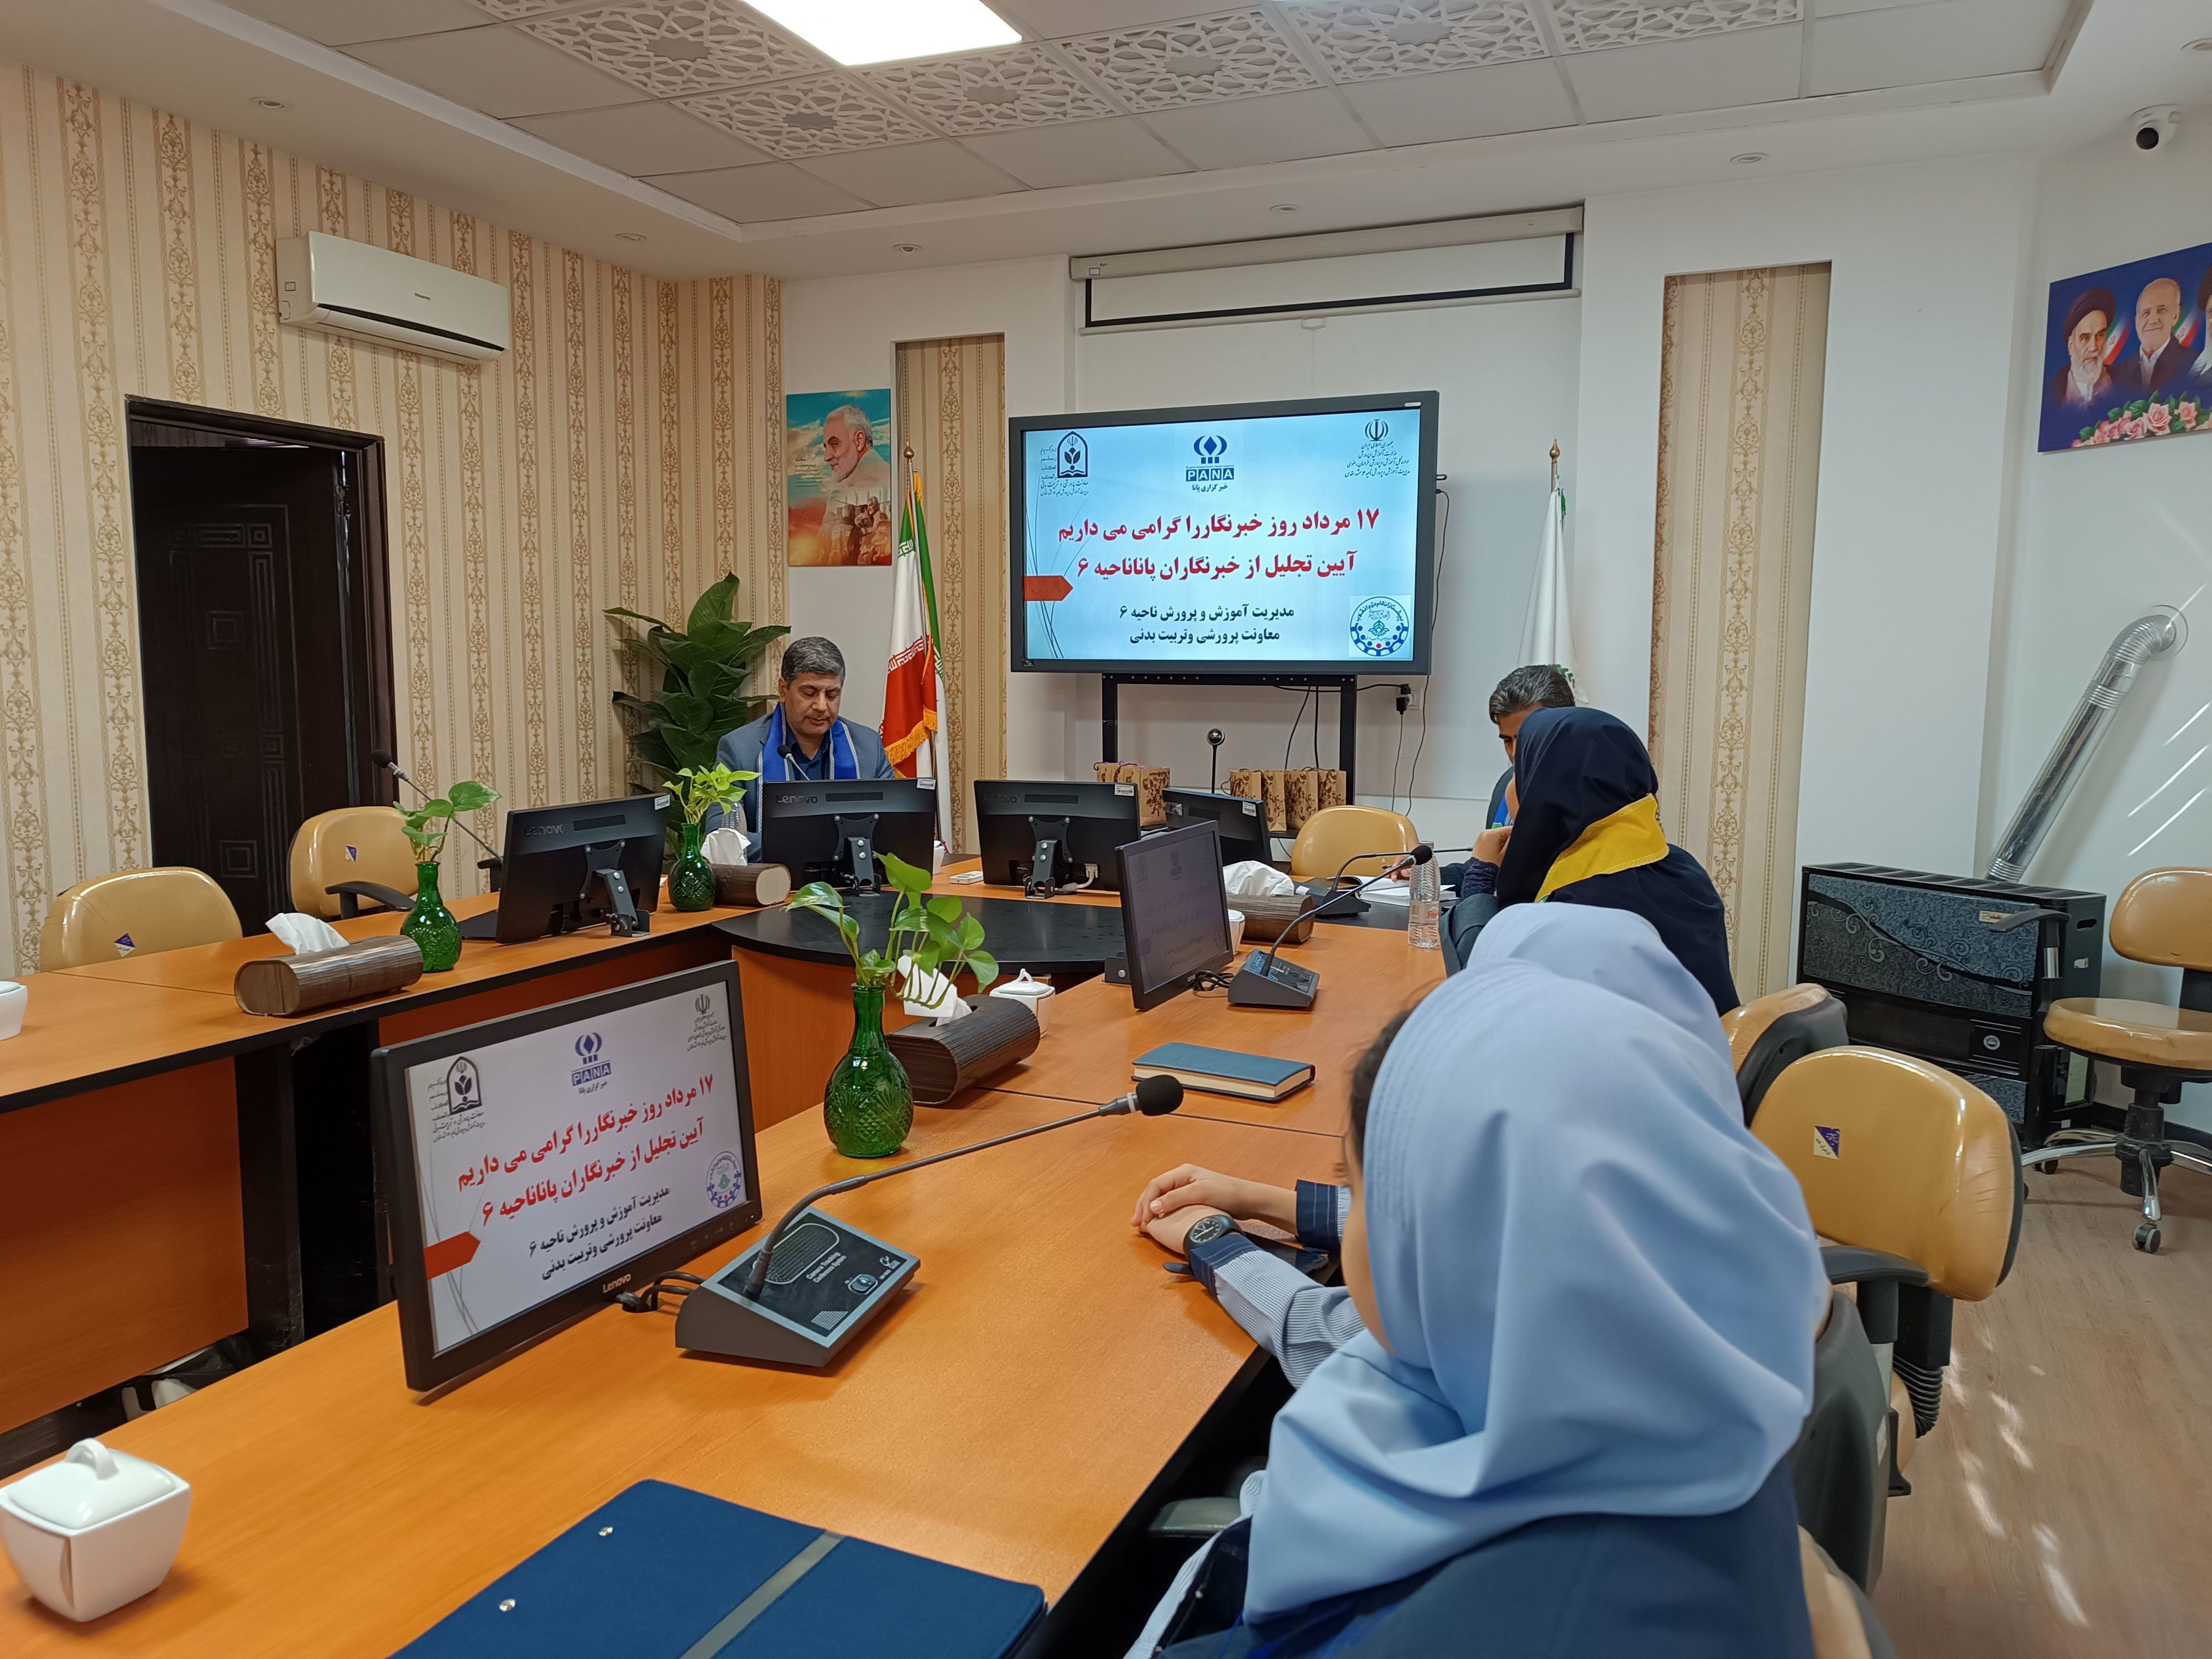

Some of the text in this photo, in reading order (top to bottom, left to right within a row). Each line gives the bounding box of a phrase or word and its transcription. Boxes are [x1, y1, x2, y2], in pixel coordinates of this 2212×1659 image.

[1187, 468, 1234, 481] PANA
[1201, 483, 1218, 492] گزاری
[1218, 483, 1228, 492] خبر
[1131, 515, 1181, 540] گرامی
[1267, 517, 1297, 537] روز
[1302, 510, 1350, 535] مرداد
[1357, 508, 1379, 529] ۱۷
[1058, 518, 1098, 542] داریم
[1103, 524, 1127, 541] می
[1078, 557, 1089, 577] ۶
[1160, 555, 1240, 581] خبرنگاران
[1244, 555, 1260, 579] از
[1265, 554, 1312, 578] تجلیل
[1317, 550, 1358, 577] آیین
[1119, 603, 1295, 622] مدیریت آموزش و پرورش ناحیه ۶
[1130, 628, 1156, 644] بدنی
[1196, 628, 1239, 645] پرورشی
[1241, 628, 1280, 644] معاونت
[775, 795, 818, 804] Lenovo
[572, 1063, 611, 1086] PANA
[700, 1073, 713, 1095] ۱۷
[665, 1088, 697, 1107] مرداد
[641, 1102, 662, 1123] روز
[531, 1124, 574, 1163] گرامی
[680, 1116, 704, 1149] آیین
[630, 1144, 640, 1171] از
[644, 1130, 677, 1164] تجلیل
[504, 1150, 527, 1173] می
[458, 1154, 499, 1192] داریم
[561, 1151, 625, 1198] خبرنگاران
[482, 1202, 493, 1227] ۶
[529, 1187, 670, 1258] مدیریت آموزش و پرورش ناحیه ۶
[634, 1214, 662, 1233] معاونت
[599, 1227, 633, 1254] پرورشی
[542, 1259, 565, 1281] بدنی
[603, 1274, 632, 1293] Lenovo
